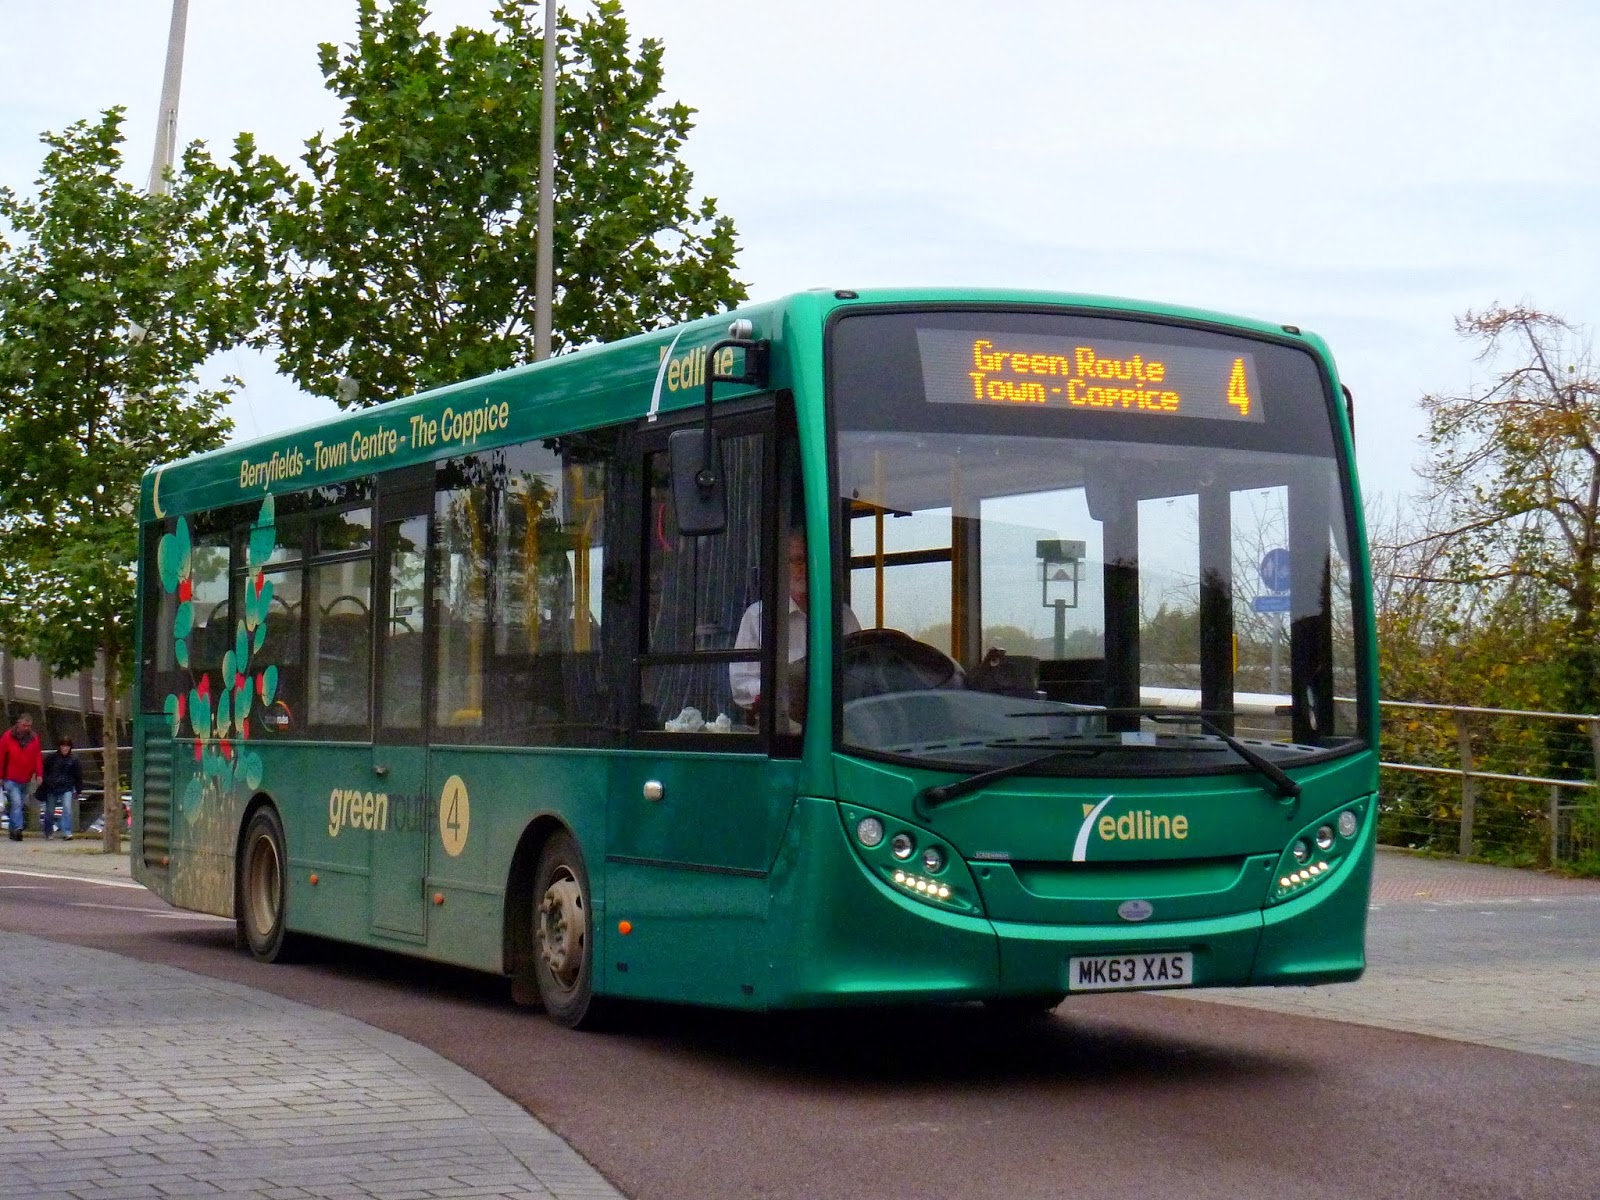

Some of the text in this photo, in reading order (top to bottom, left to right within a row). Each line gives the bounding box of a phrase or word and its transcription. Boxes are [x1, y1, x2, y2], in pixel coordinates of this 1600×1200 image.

[972, 339, 1165, 383] Green Route
[969, 372, 1047, 403] Town
[1226, 358, 1249, 416] 4
[240, 446, 304, 490] Berryfields
[314, 440, 348, 471] Town
[350, 425, 398, 462] Centre
[410, 414, 437, 448] The
[441, 398, 509, 446] Coppice
[446, 788, 461, 841] 4
[1078, 956, 1184, 984] MK63 XAS
